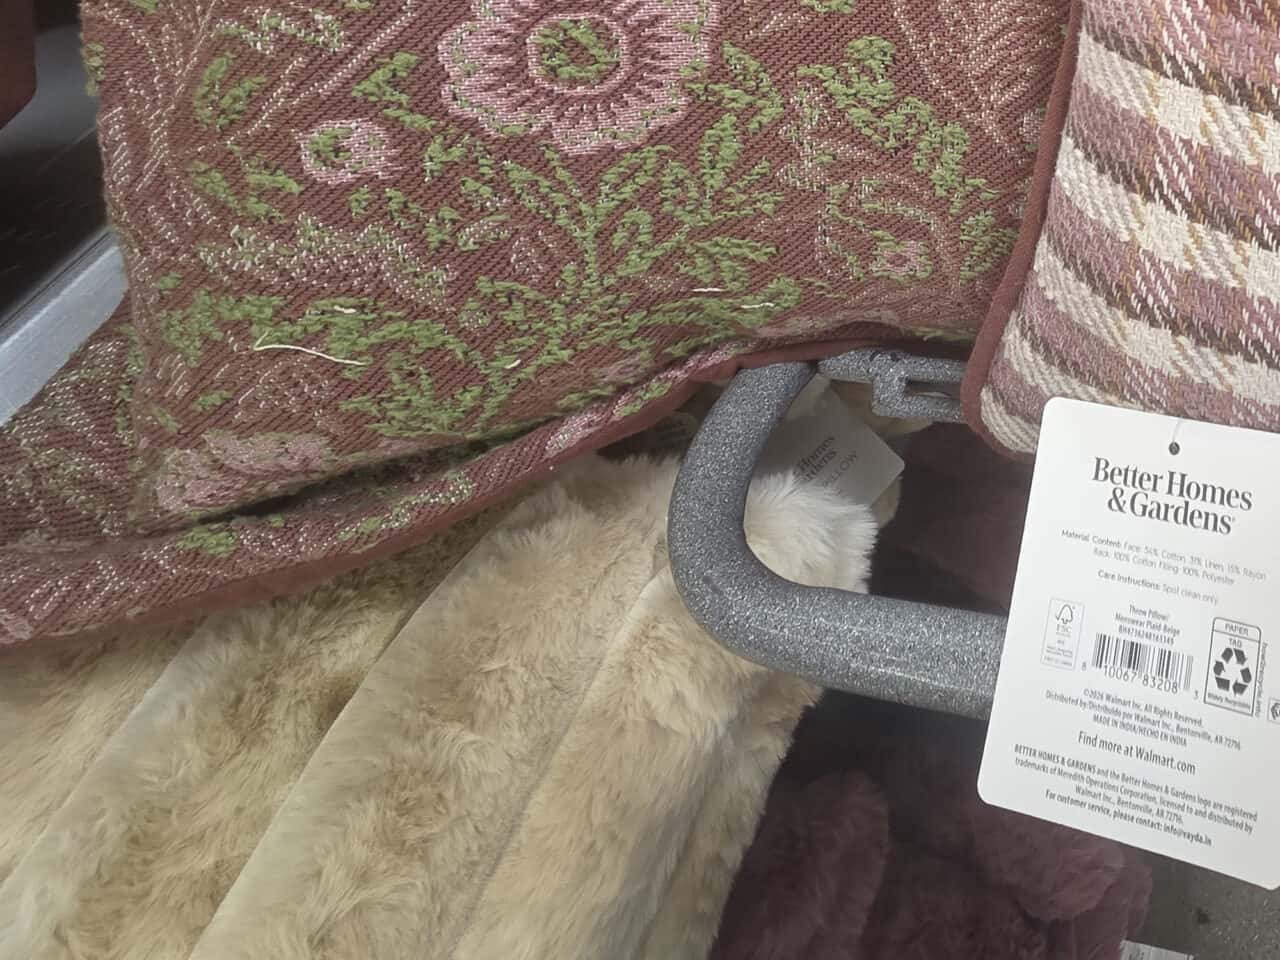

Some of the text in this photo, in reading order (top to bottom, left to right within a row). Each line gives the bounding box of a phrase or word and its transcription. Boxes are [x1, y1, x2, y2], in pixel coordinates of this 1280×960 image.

[1091, 456, 1254, 511] Better Homes
[1097, 568, 1116, 580] Care
[1116, 572, 1161, 591] Instructions:
[1161, 583, 1179, 597] Spot
[1180, 585, 1202, 600] clean
[1112, 550, 1131, 562] 100%
[1181, 565, 1199, 577] 100%
[1201, 569, 1235, 587] Polyester
[1145, 619, 1162, 632] Plaid
[1102, 663, 1137, 684] 10067
[1141, 672, 1179, 695] 83208
[1045, 688, 1079, 707] Distributed
[1133, 712, 1160, 728] Walmart
[1104, 692, 1131, 708] Walmart
[1143, 702, 1153, 714] All
[1152, 705, 1173, 721] Rights
[1091, 712, 1110, 726] MADE
[1110, 717, 1118, 729] IN
[1159, 730, 1169, 742] EN
[1168, 733, 1188, 748] INDIA
[1077, 729, 1197, 776] Find more at Walmart.com
[1013, 742, 1037, 758] BETTER
[1036, 749, 1060, 765] HOMES
[1065, 757, 1096, 775] GARDENS
[1096, 766, 1109, 778] and
[1108, 769, 1120, 781] the
[1120, 773, 1141, 788] Better
[1140, 778, 1163, 794] Homes
[1169, 787, 1197, 804] Gardens
[1223, 803, 1258, 824] registered
[1014, 755, 1050, 774] trademarks
[1049, 765, 1057, 776] of
[1085, 775, 1120, 796] Operations
[1158, 797, 1186, 813] licensed
[1194, 807, 1207, 819] and
[1207, 811, 1244, 831] distributed
[1243, 822, 1253, 835] by
[1074, 784, 1103, 801] Walmart
[1155, 807, 1165, 819] AR
[1045, 788, 1057, 800] For
[1056, 792, 1087, 809] customer
[1087, 802, 1113, 818] service,
[1112, 808, 1135, 824] please
[1134, 815, 1163, 832] contact:
